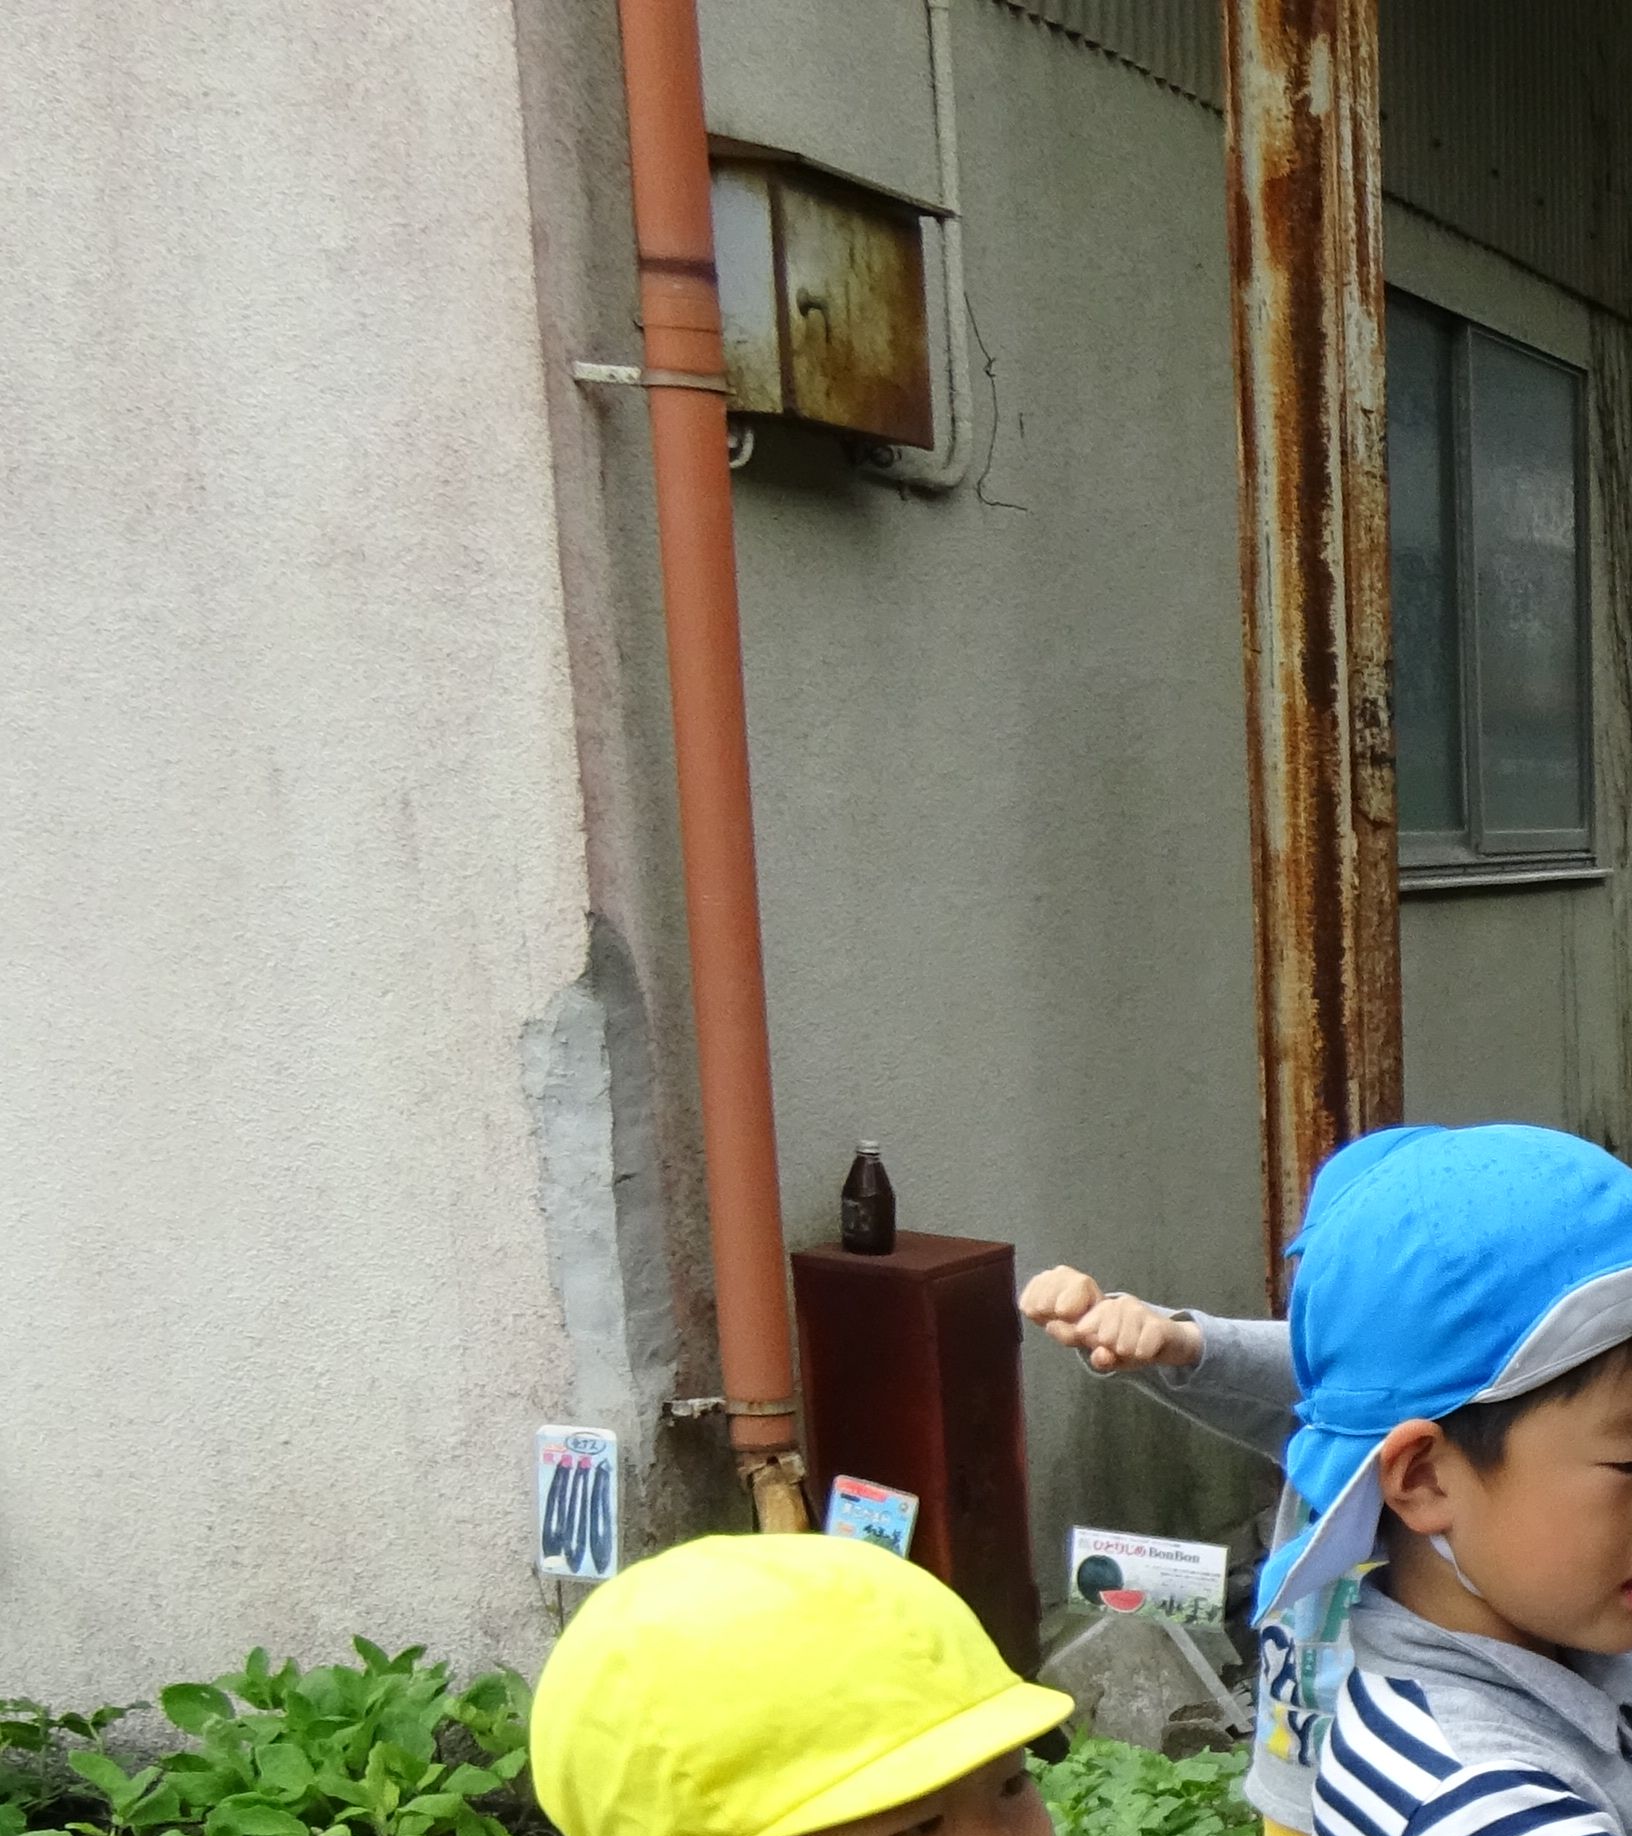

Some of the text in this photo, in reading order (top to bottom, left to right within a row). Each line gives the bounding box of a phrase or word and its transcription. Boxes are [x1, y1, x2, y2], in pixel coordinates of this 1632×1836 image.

[1093, 1540, 1201, 1563] ひとりじめ BonBon
